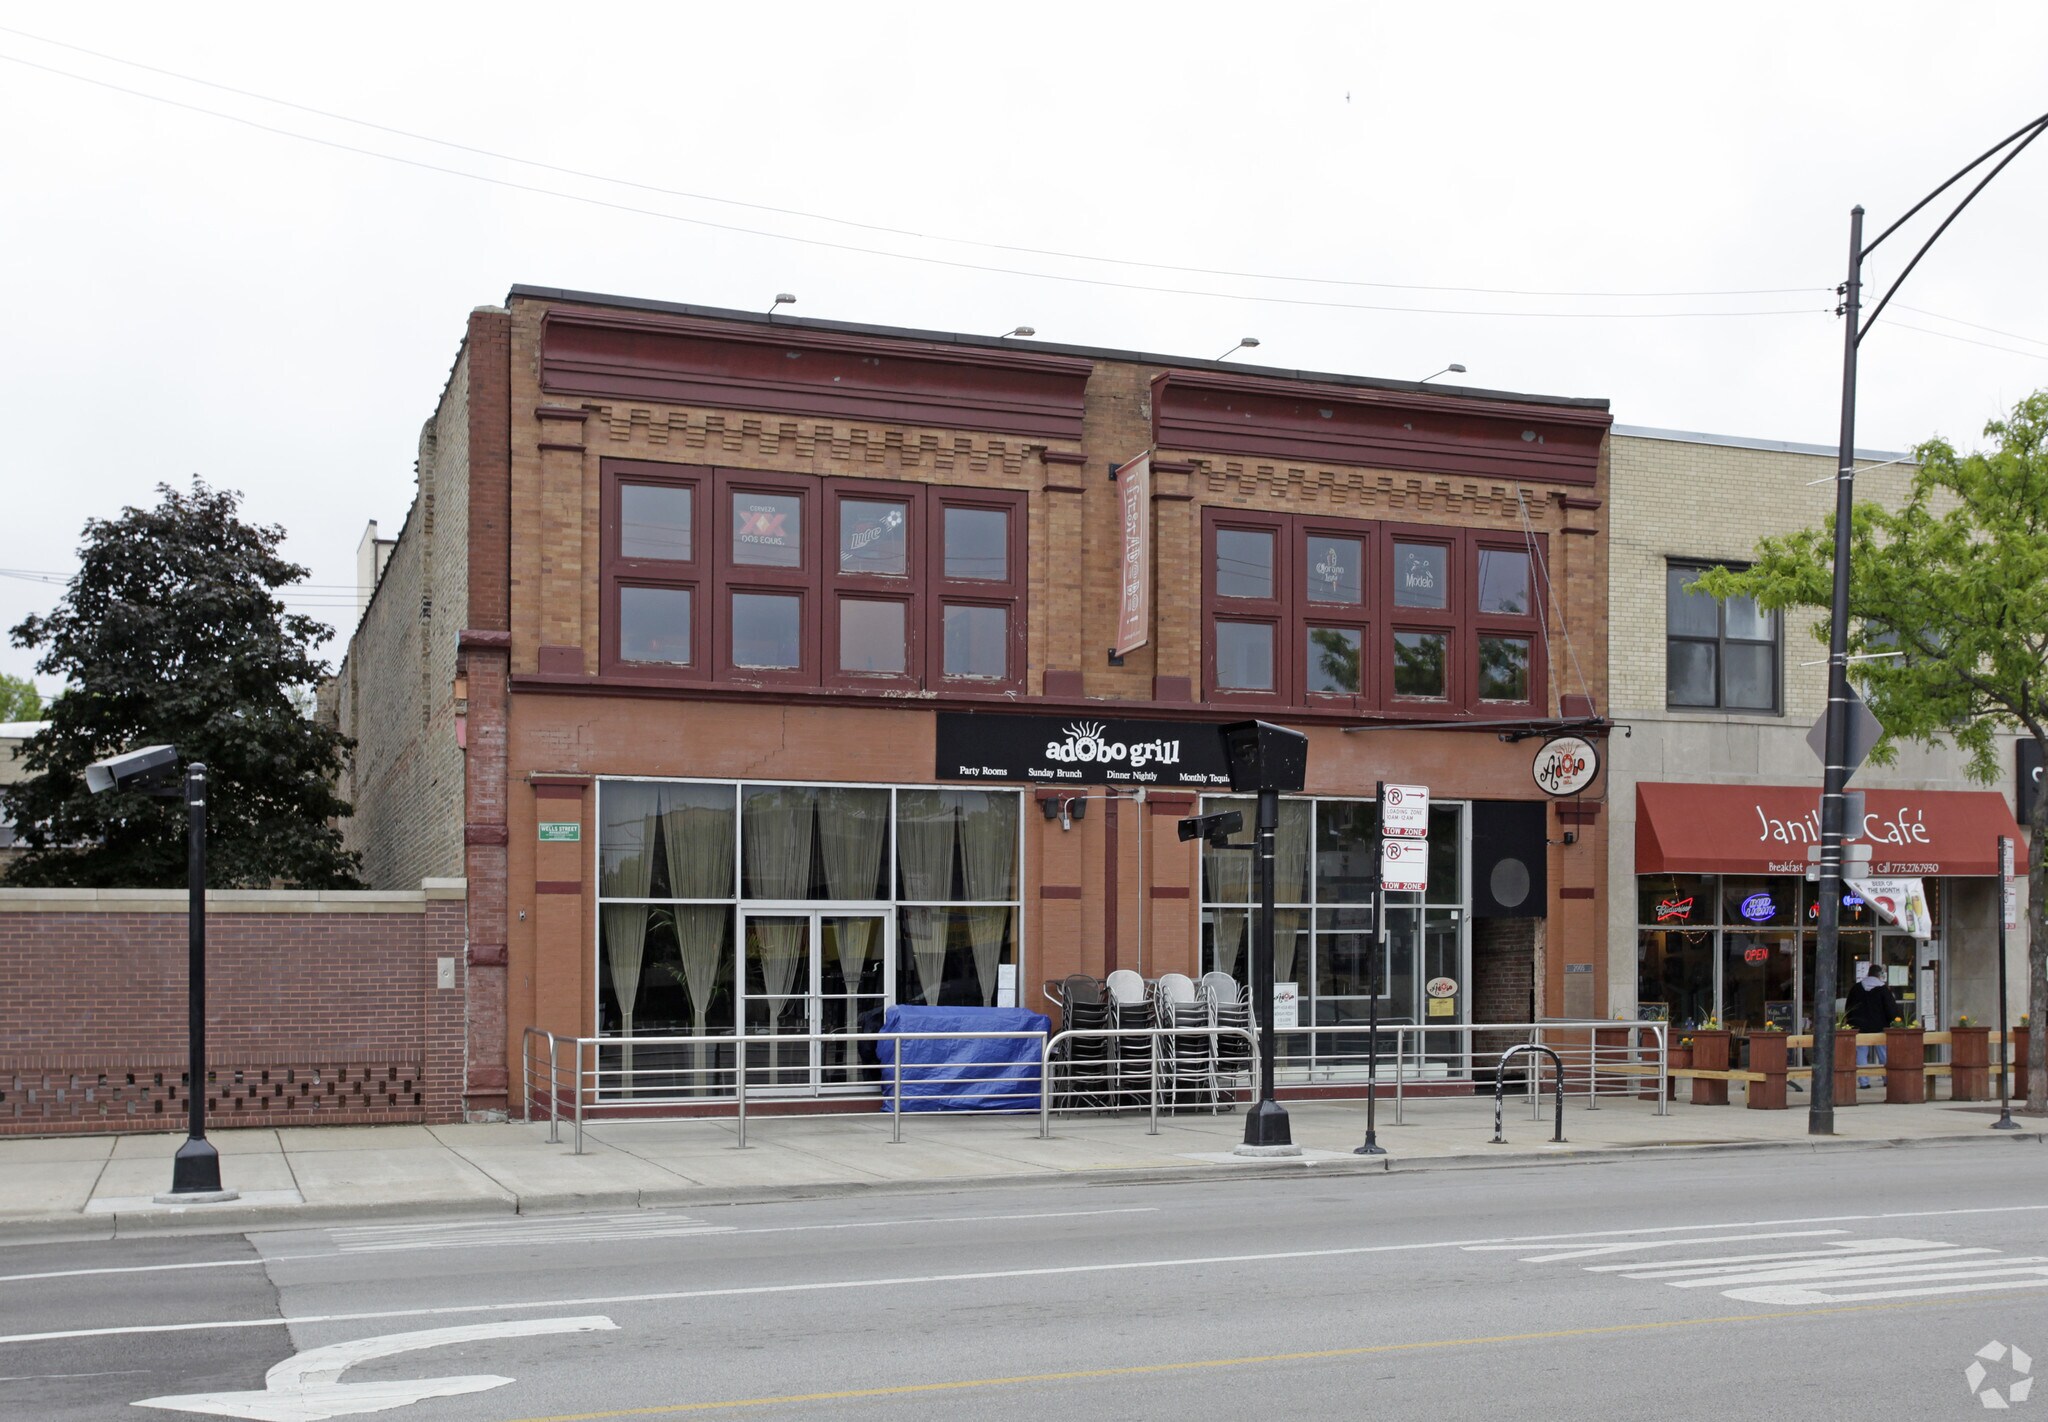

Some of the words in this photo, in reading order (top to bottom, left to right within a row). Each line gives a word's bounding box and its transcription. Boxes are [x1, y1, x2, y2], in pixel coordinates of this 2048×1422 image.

[750, 505, 776, 513] CERVEZA
[741, 535, 759, 544] DOS
[1405, 572, 1434, 588] Modelo
[1129, 738, 1180, 767] grill
[959, 765, 980, 777] Party
[982, 766, 1008, 776] Rooms
[1028, 767, 1055, 779] Sunday
[1056, 768, 1083, 778] Brunch
[1106, 770, 1131, 780] Dinner
[1132, 771, 1158, 782] Nightly
[1179, 772, 1208, 784] Monthly
[1209, 773, 1230, 784] Tequi
[1385, 827, 1401, 835] TOW
[1404, 828, 1423, 836] ZONE
[1863, 807, 1930, 846] Café
[1768, 861, 1803, 873] Breakfast
[1876, 861, 1891, 874] Call
[1384, 882, 1400, 890] TOW
[1403, 882, 1422, 891] ZONE
[1749, 897, 1771, 907] BUD
[1656, 904, 1692, 916] Budweiser
[1745, 905, 1776, 917] LIGHT
[1744, 949, 1769, 961] OPEN
